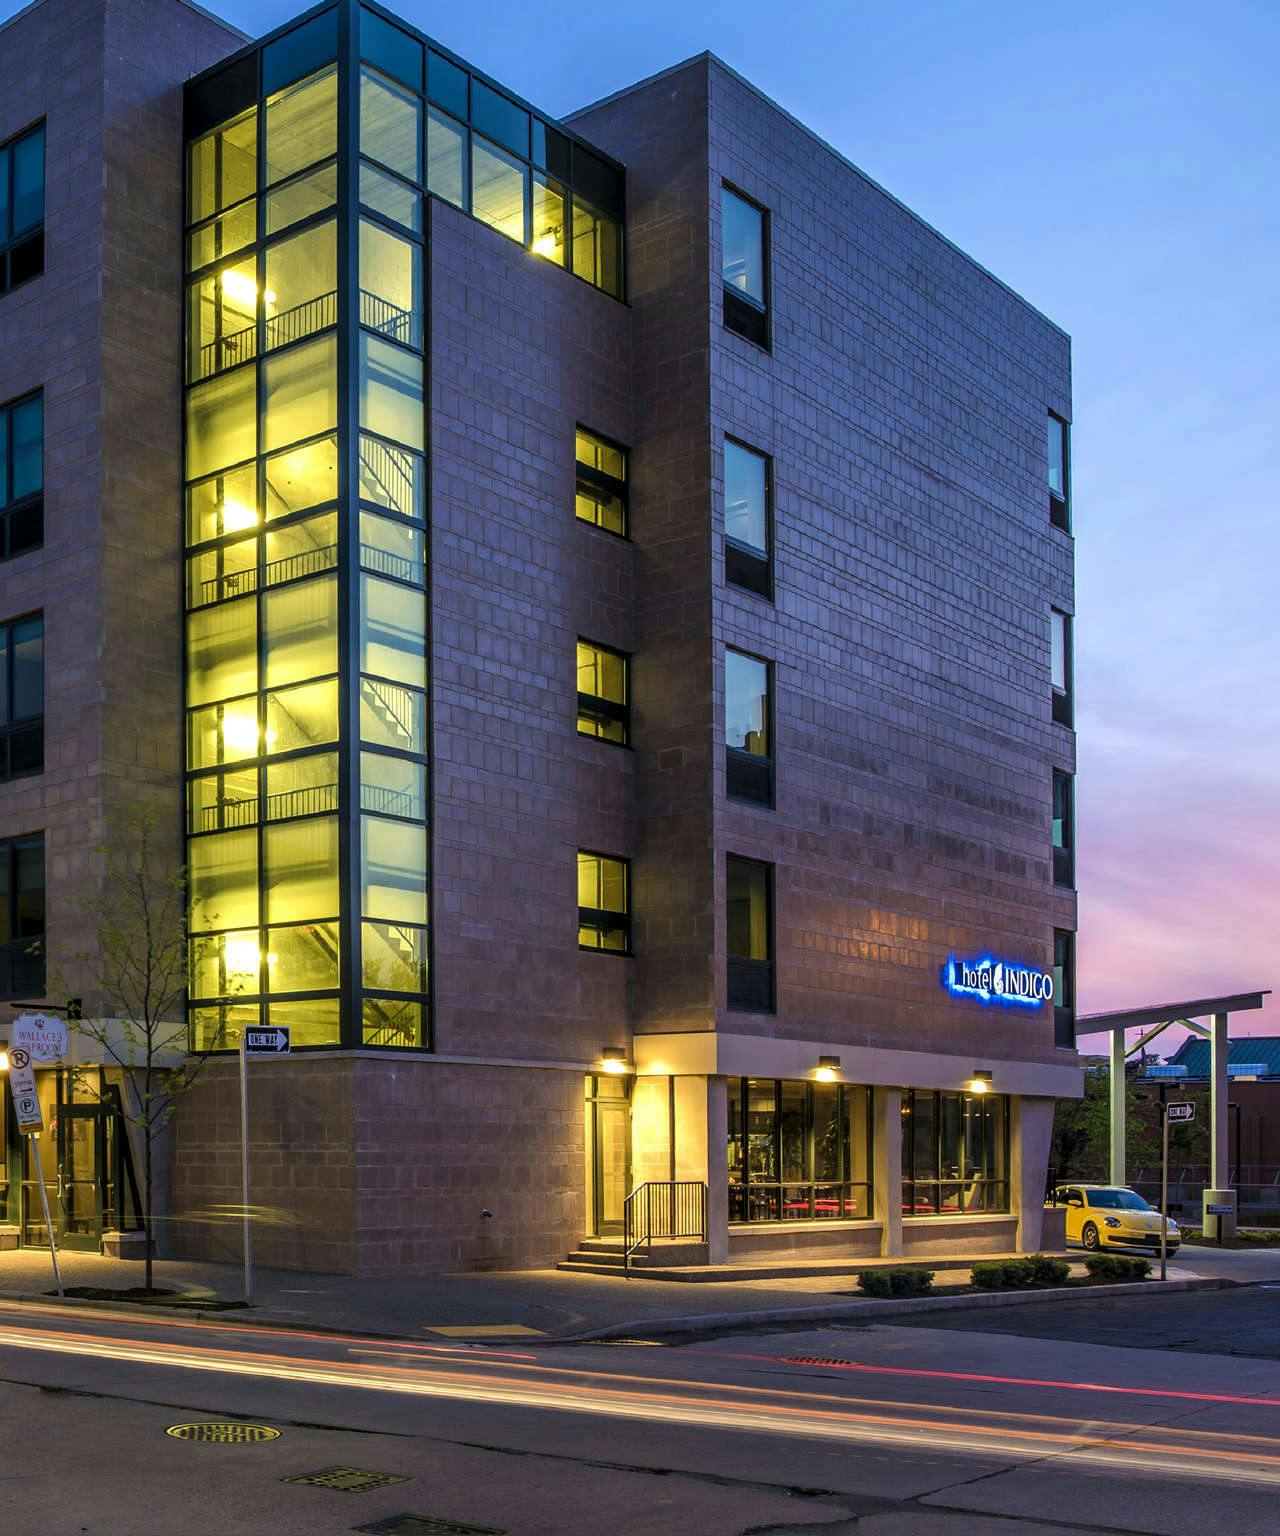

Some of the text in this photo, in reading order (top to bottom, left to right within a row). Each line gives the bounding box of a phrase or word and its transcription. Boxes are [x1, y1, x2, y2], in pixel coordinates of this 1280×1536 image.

[962, 962, 1053, 1000] hotel INDIGO
[18, 1031, 63, 1042] WALLACE'S
[250, 1034, 263, 1045] ONE
